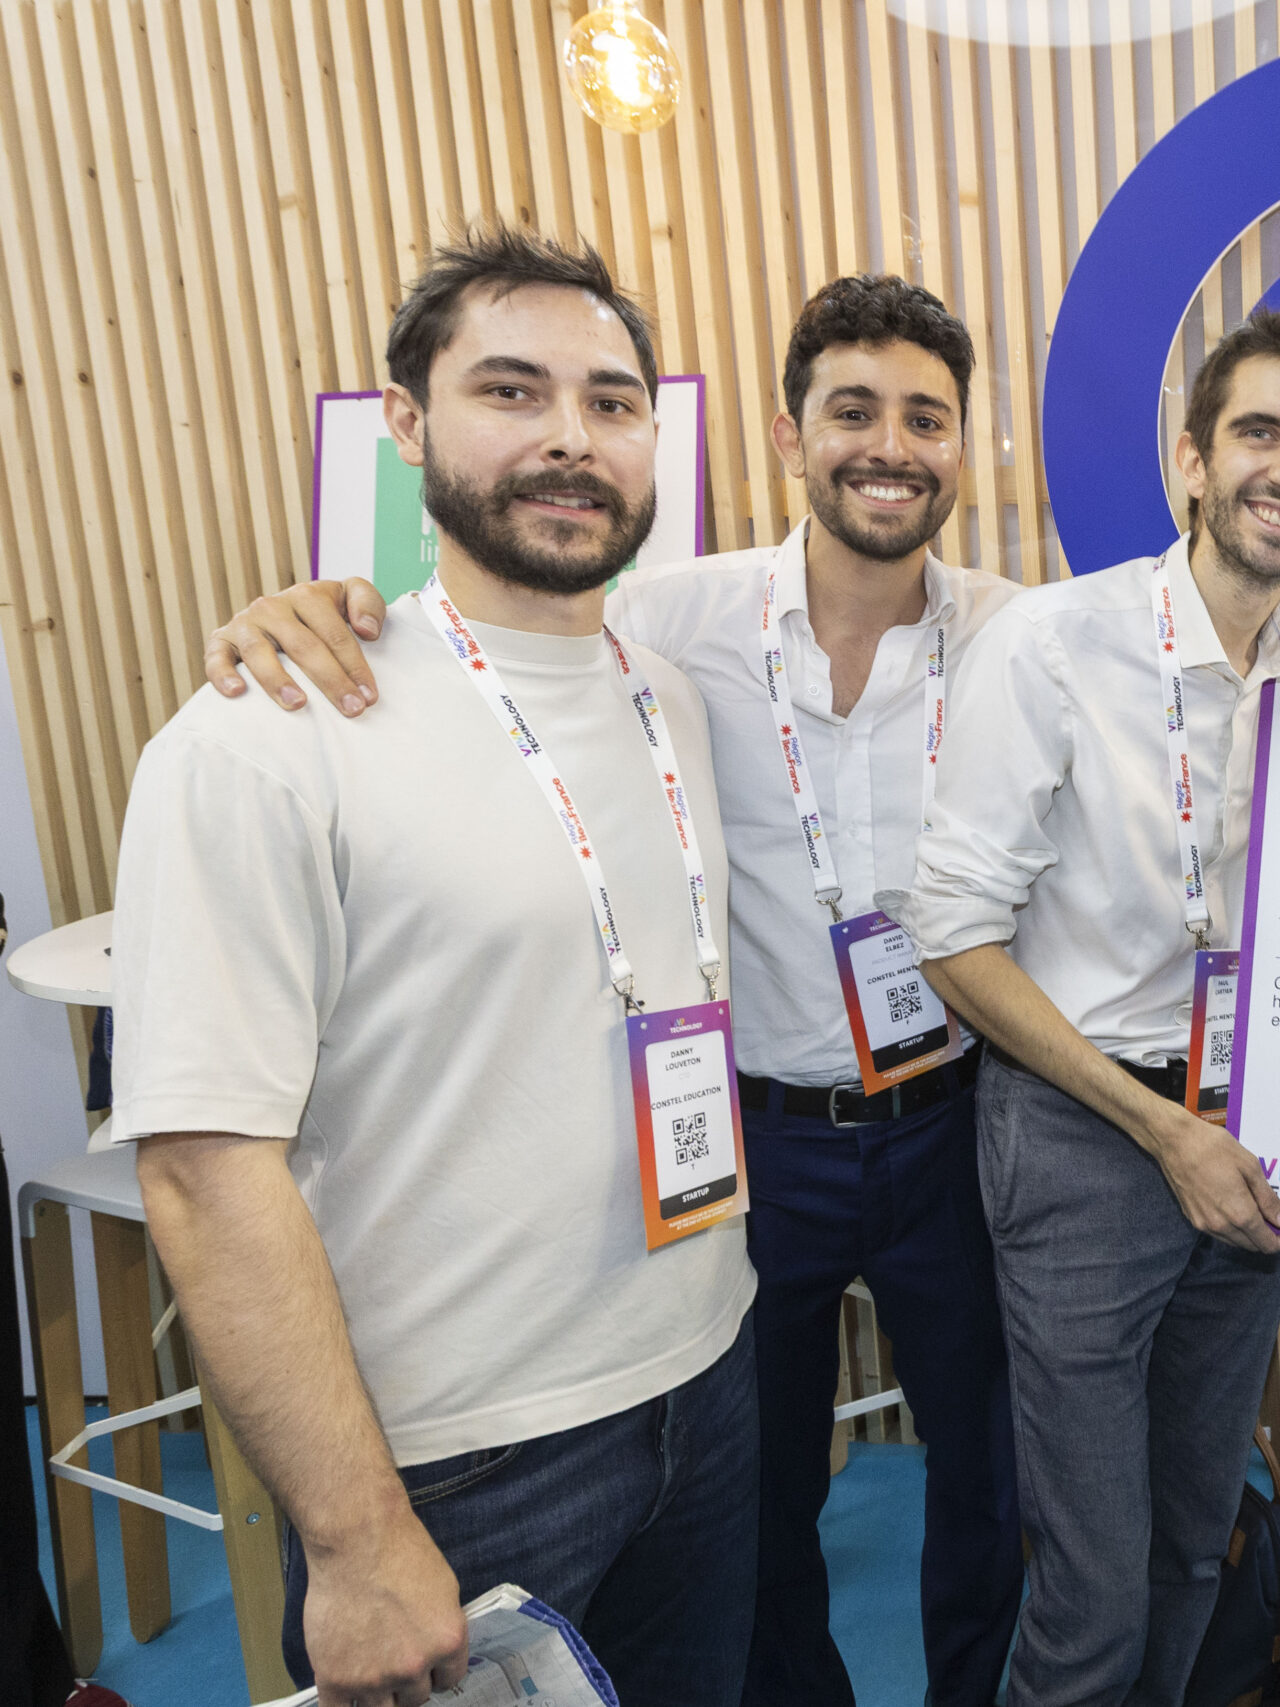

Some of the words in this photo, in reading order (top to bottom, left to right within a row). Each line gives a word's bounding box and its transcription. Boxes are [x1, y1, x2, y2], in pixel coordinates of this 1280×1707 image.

[764, 650, 779, 703] TECHNOLOGY
[928, 653, 937, 678] VIVA
[1177, 675, 1185, 732] TECHNOLOGY
[499, 694, 542, 755] TECHNOLOGY
[631, 692, 659, 747] TECHNOLOGY
[808, 812, 823, 840] VIVA
[800, 815, 821, 869] TECHNOLOGY
[1190, 844, 1204, 899] TECHNOLOGY
[598, 886, 622, 954] TECHNOLOGY
[688, 875, 706, 939] TECHNOLOGY
[883, 933, 904, 945] DAVID
[866, 970, 897, 985] CONSTEL
[670, 1047, 694, 1059] DANNY
[898, 1035, 925, 1051] STARTUP
[664, 1056, 701, 1072] LOUVETON
[651, 1096, 683, 1111] CONSTEL
[683, 1085, 722, 1104] EDUCATION
[681, 1186, 710, 1203] STARTUP
